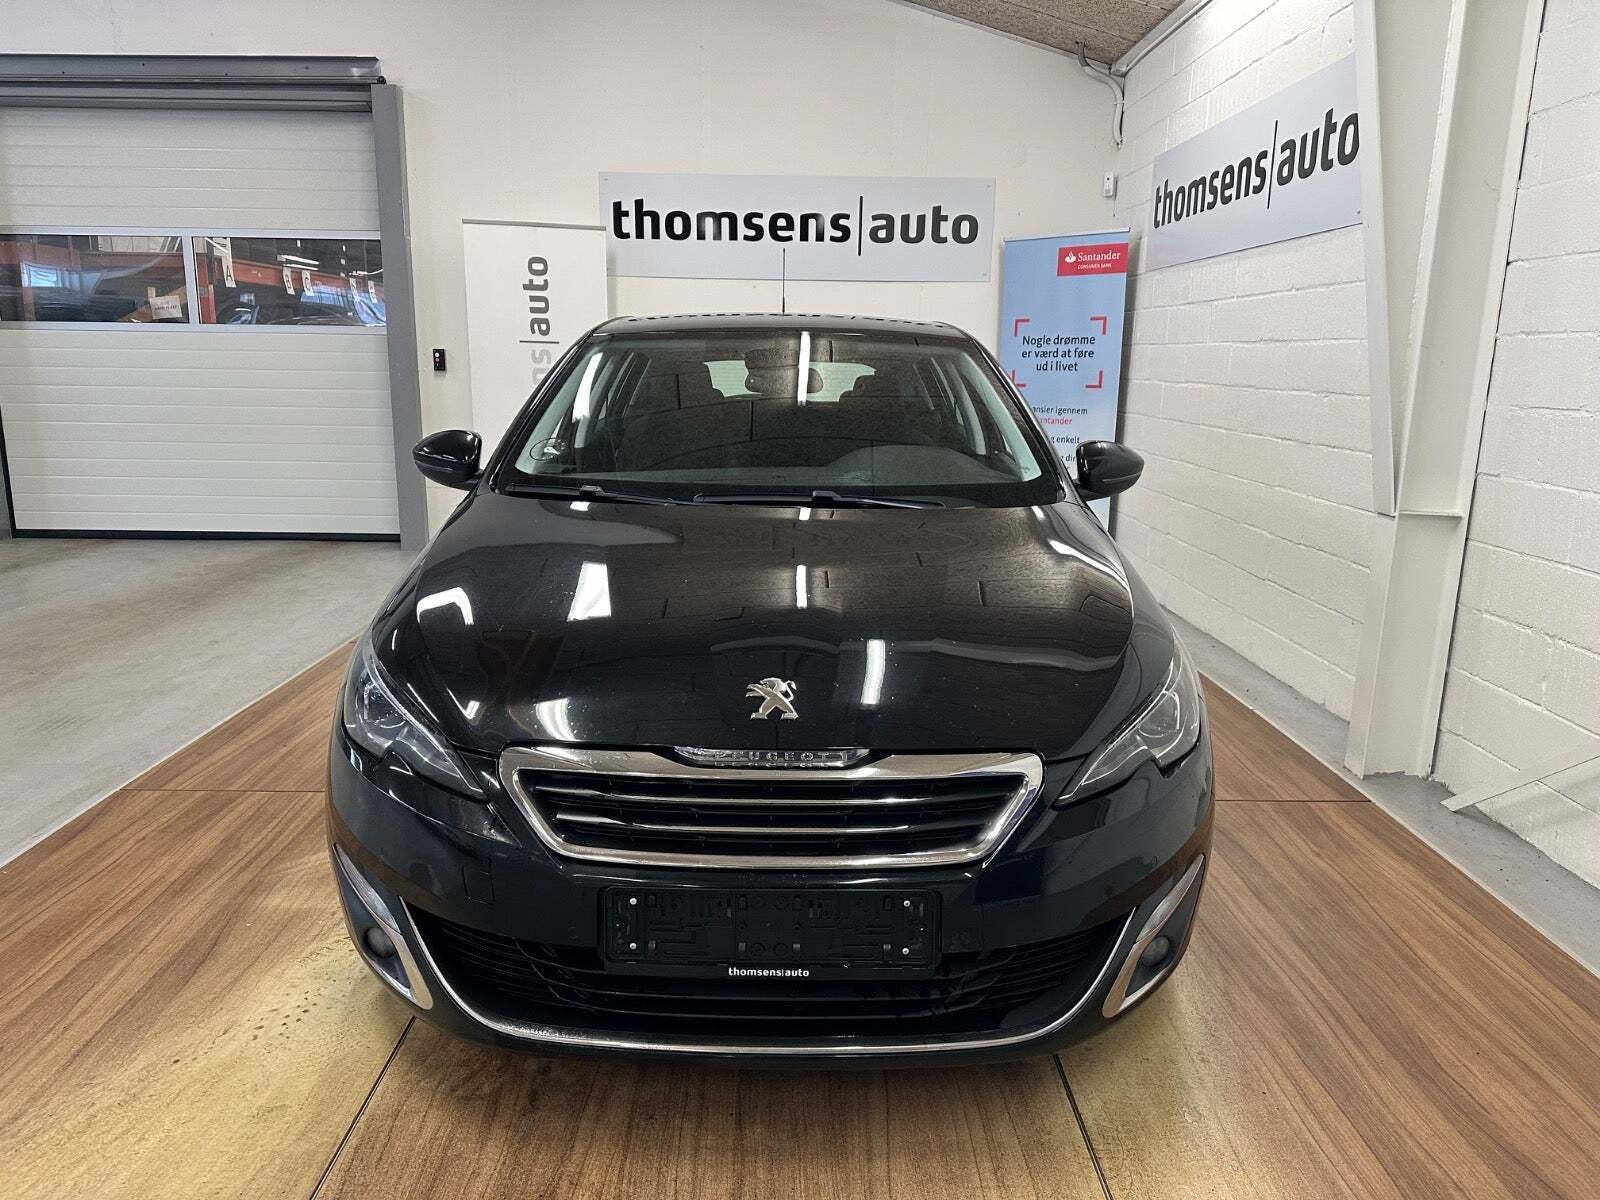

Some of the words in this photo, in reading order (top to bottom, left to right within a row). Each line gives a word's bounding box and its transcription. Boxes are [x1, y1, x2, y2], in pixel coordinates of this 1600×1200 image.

[1077, 249, 1120, 262] Santander
[225, 264, 234, 280] A
[1022, 334, 1051, 348] Nogle
[1053, 334, 1096, 345] drømme
[1021, 350, 1032, 358] er
[1034, 347, 1059, 358] værd
[1060, 348, 1072, 358] at
[1074, 347, 1095, 359] føre
[1036, 360, 1048, 371] ud
[1050, 361, 1054, 371] i
[1055, 360, 1079, 371] livet
[1055, 405, 1088, 416] igennem
[1056, 435, 1080, 444] enkelt
